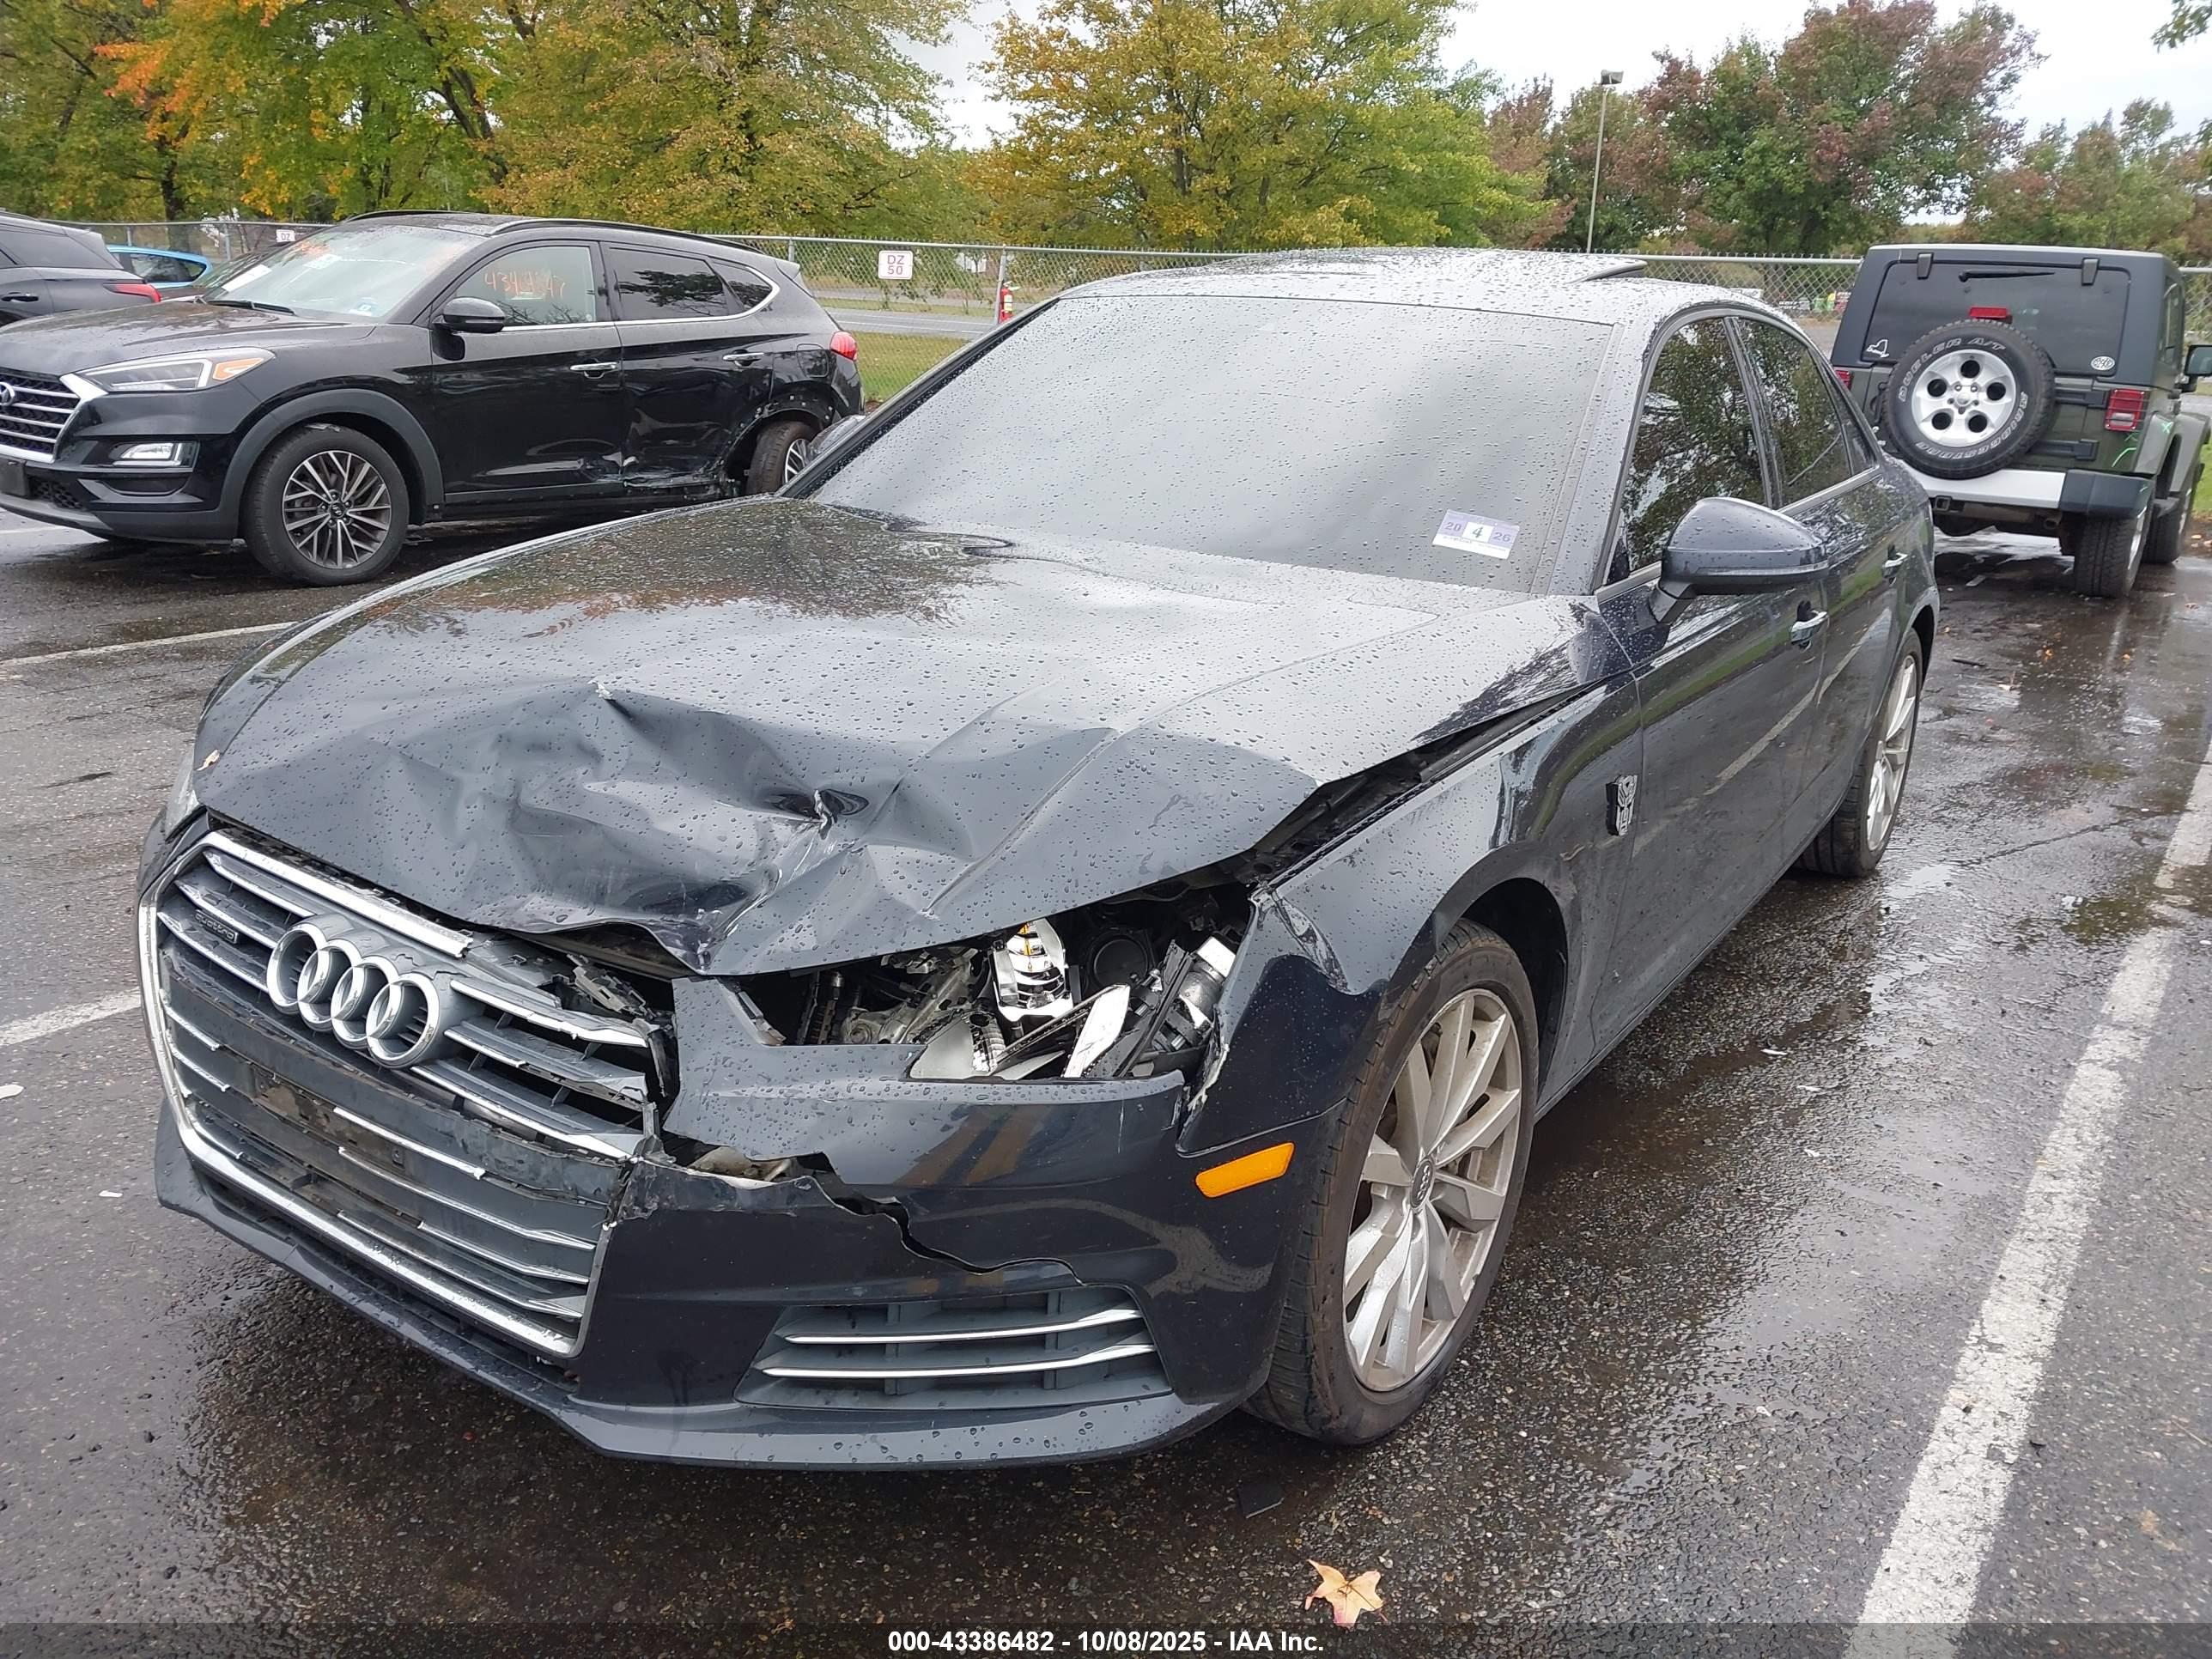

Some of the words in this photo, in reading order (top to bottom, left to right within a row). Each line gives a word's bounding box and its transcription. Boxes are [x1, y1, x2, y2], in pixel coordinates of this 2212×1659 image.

[888, 255, 904, 264] DZ
[888, 266, 902, 275] 50
[1899, 337, 1961, 402] DUELER
[1967, 337, 2006, 350] A/T
[1917, 392, 2028, 459] BRIDGESTONE
[1444, 521, 1462, 532] 20
[1472, 526, 1484, 538] 4
[1492, 532, 1511, 543] 26
[195, 912, 234, 939] quattro
